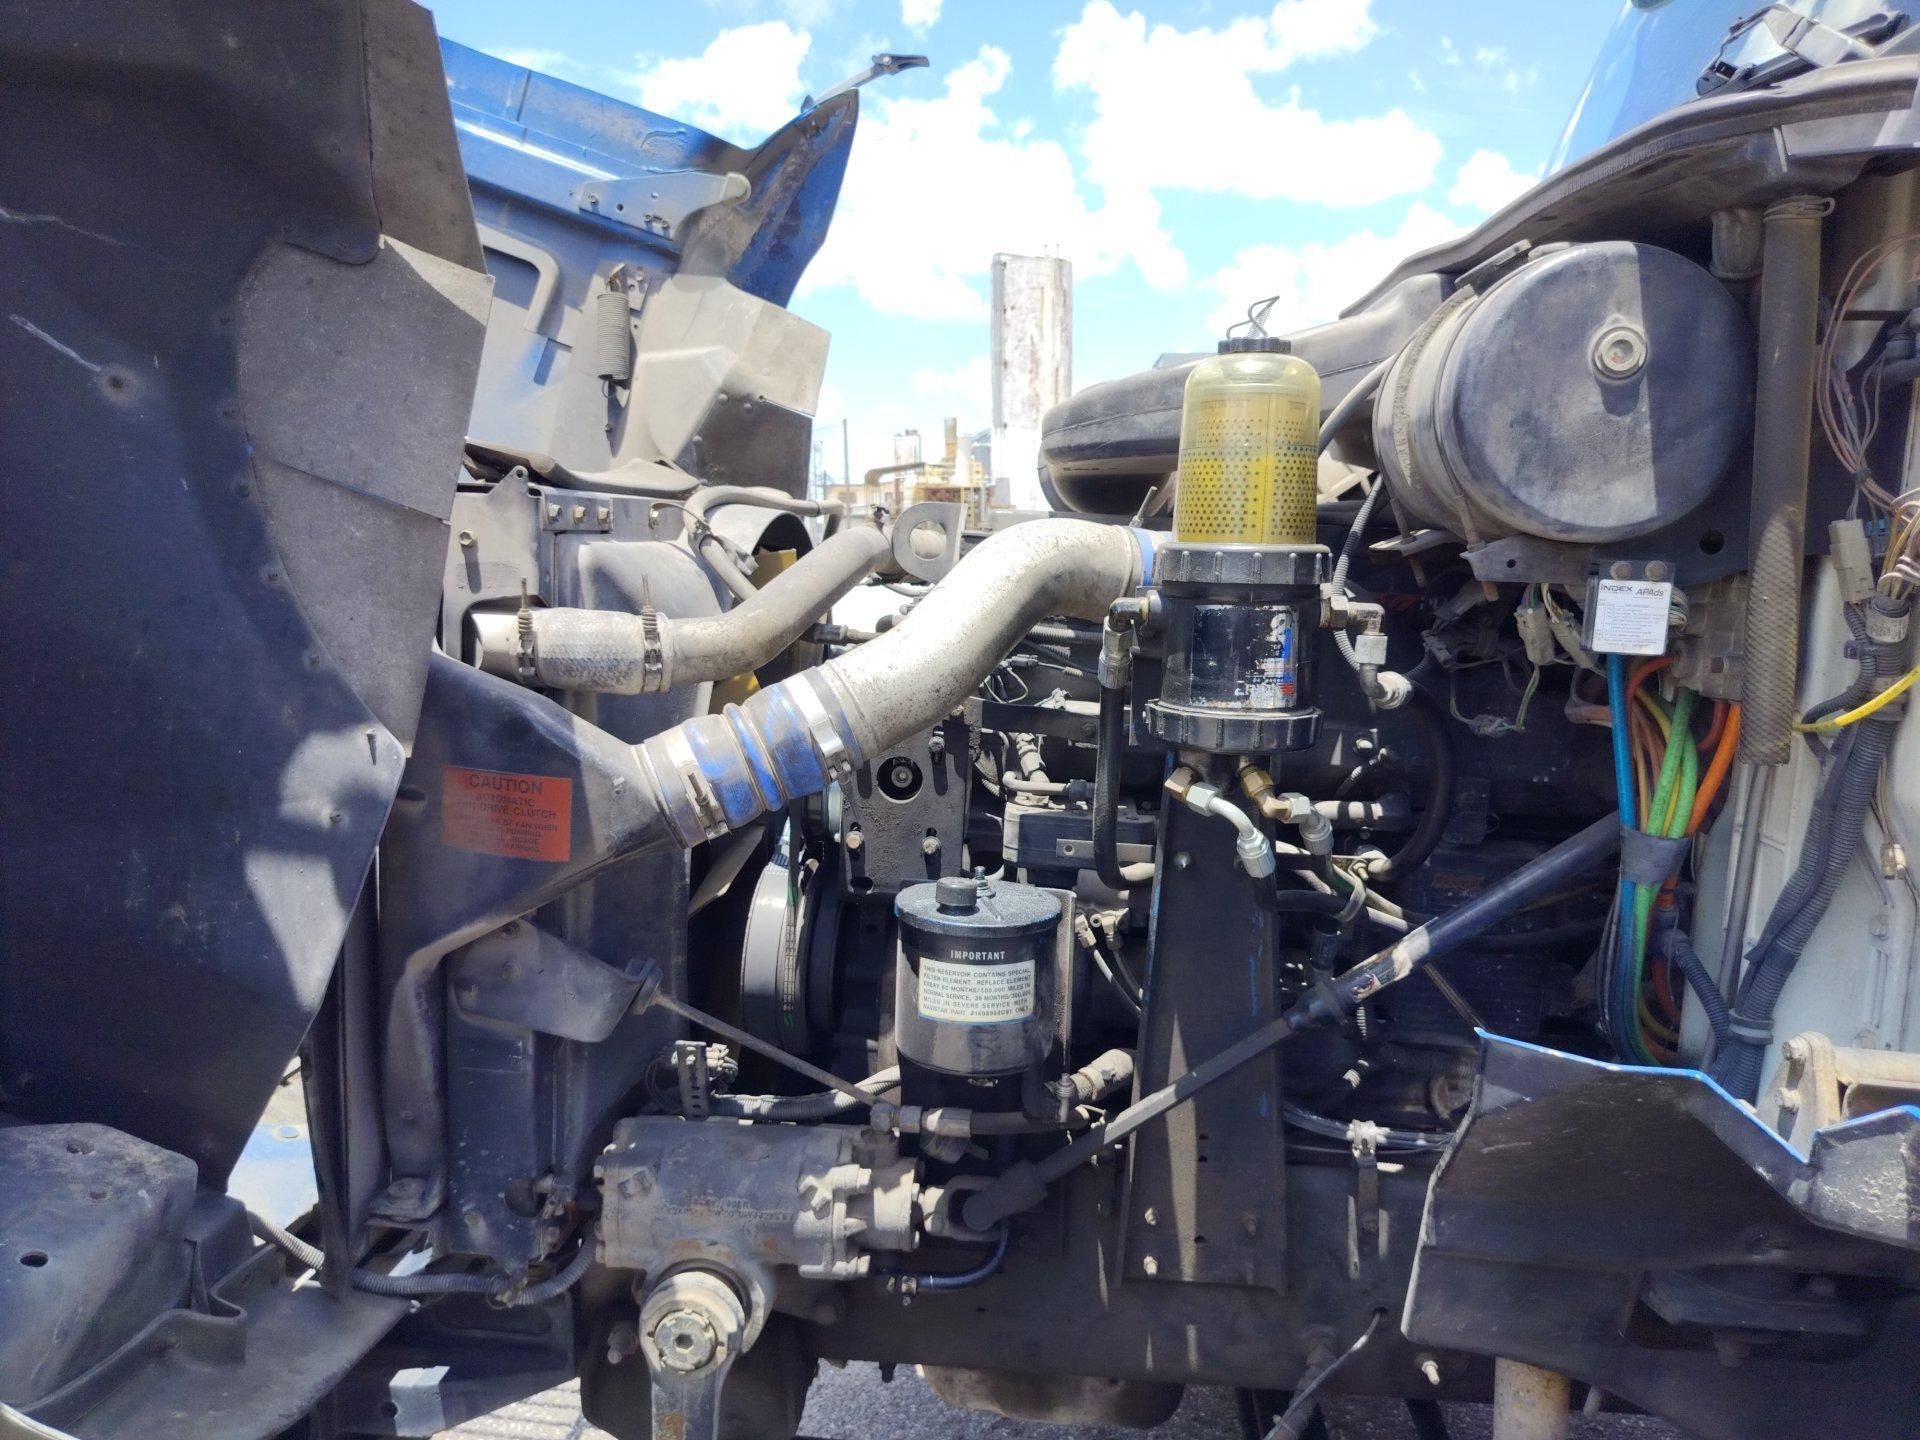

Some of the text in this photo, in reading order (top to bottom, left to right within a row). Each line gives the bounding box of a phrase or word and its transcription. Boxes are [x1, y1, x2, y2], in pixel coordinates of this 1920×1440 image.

[1600, 584, 1664, 596] INDEX APAds
[469, 774, 542, 794] CAUTION
[513, 806, 556, 820] CLUTCH
[950, 950, 1006, 960] IMPORTANT
[924, 964, 936, 973] THIS
[938, 968, 972, 978] RESERVOIR
[1008, 968, 1030, 976] SPECIAL
[924, 972, 940, 981] FILTER
[1006, 974, 1031, 984] ELEMENT
[924, 980, 940, 988] EVERY
[1008, 983, 1024, 991] MILES
[924, 988, 944, 998] NORMAL
[924, 995, 941, 1005] MILES
[952, 1001, 979, 1009] SEVERE
[1013, 998, 1028, 1006] WITH
